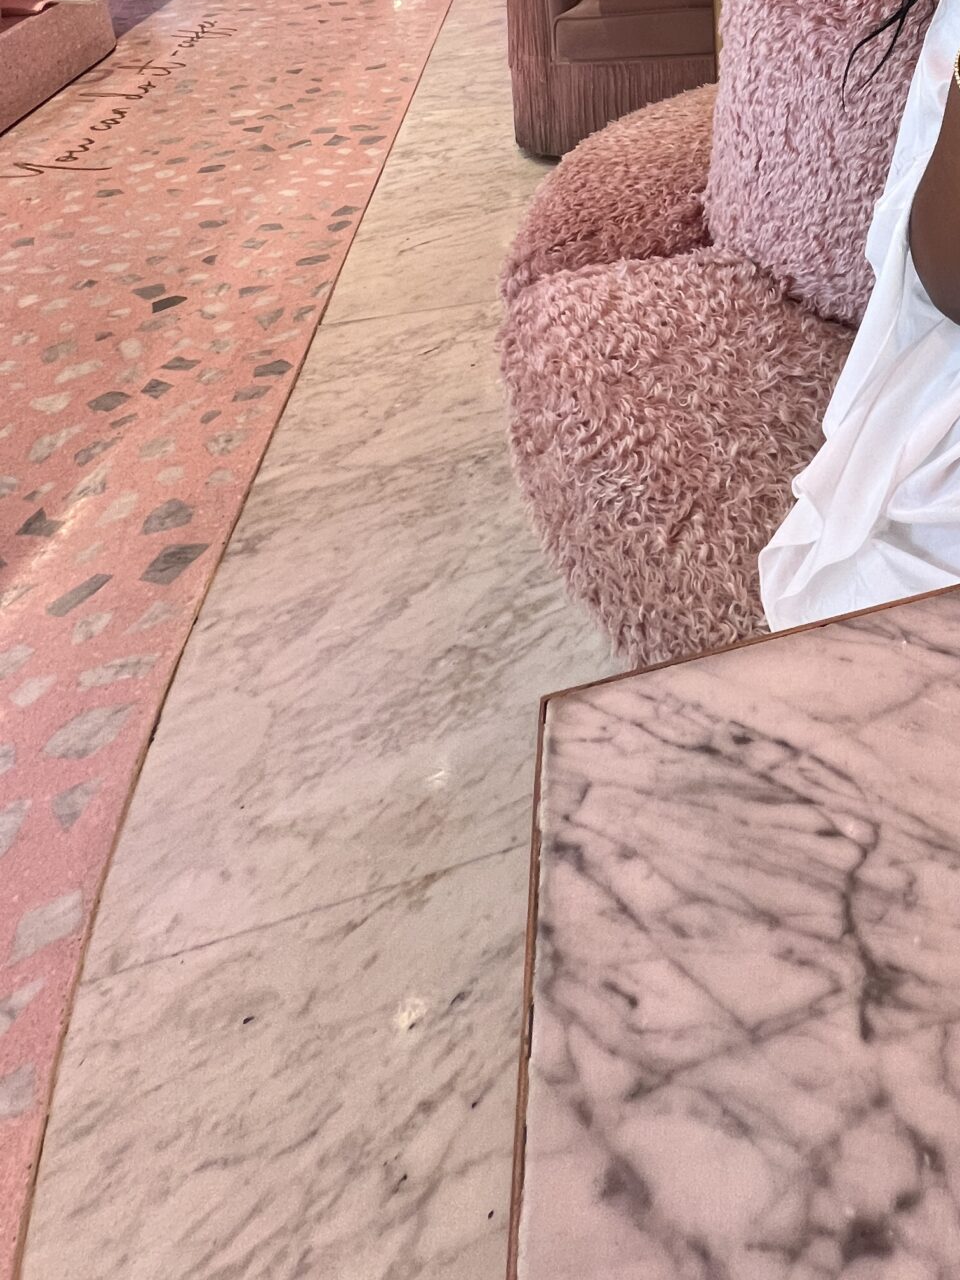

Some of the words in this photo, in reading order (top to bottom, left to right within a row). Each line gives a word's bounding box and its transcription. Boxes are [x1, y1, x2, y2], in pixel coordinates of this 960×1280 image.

[78, 80, 156, 100] do
[89, 106, 131, 131] can
[0, 137, 113, 178] You
